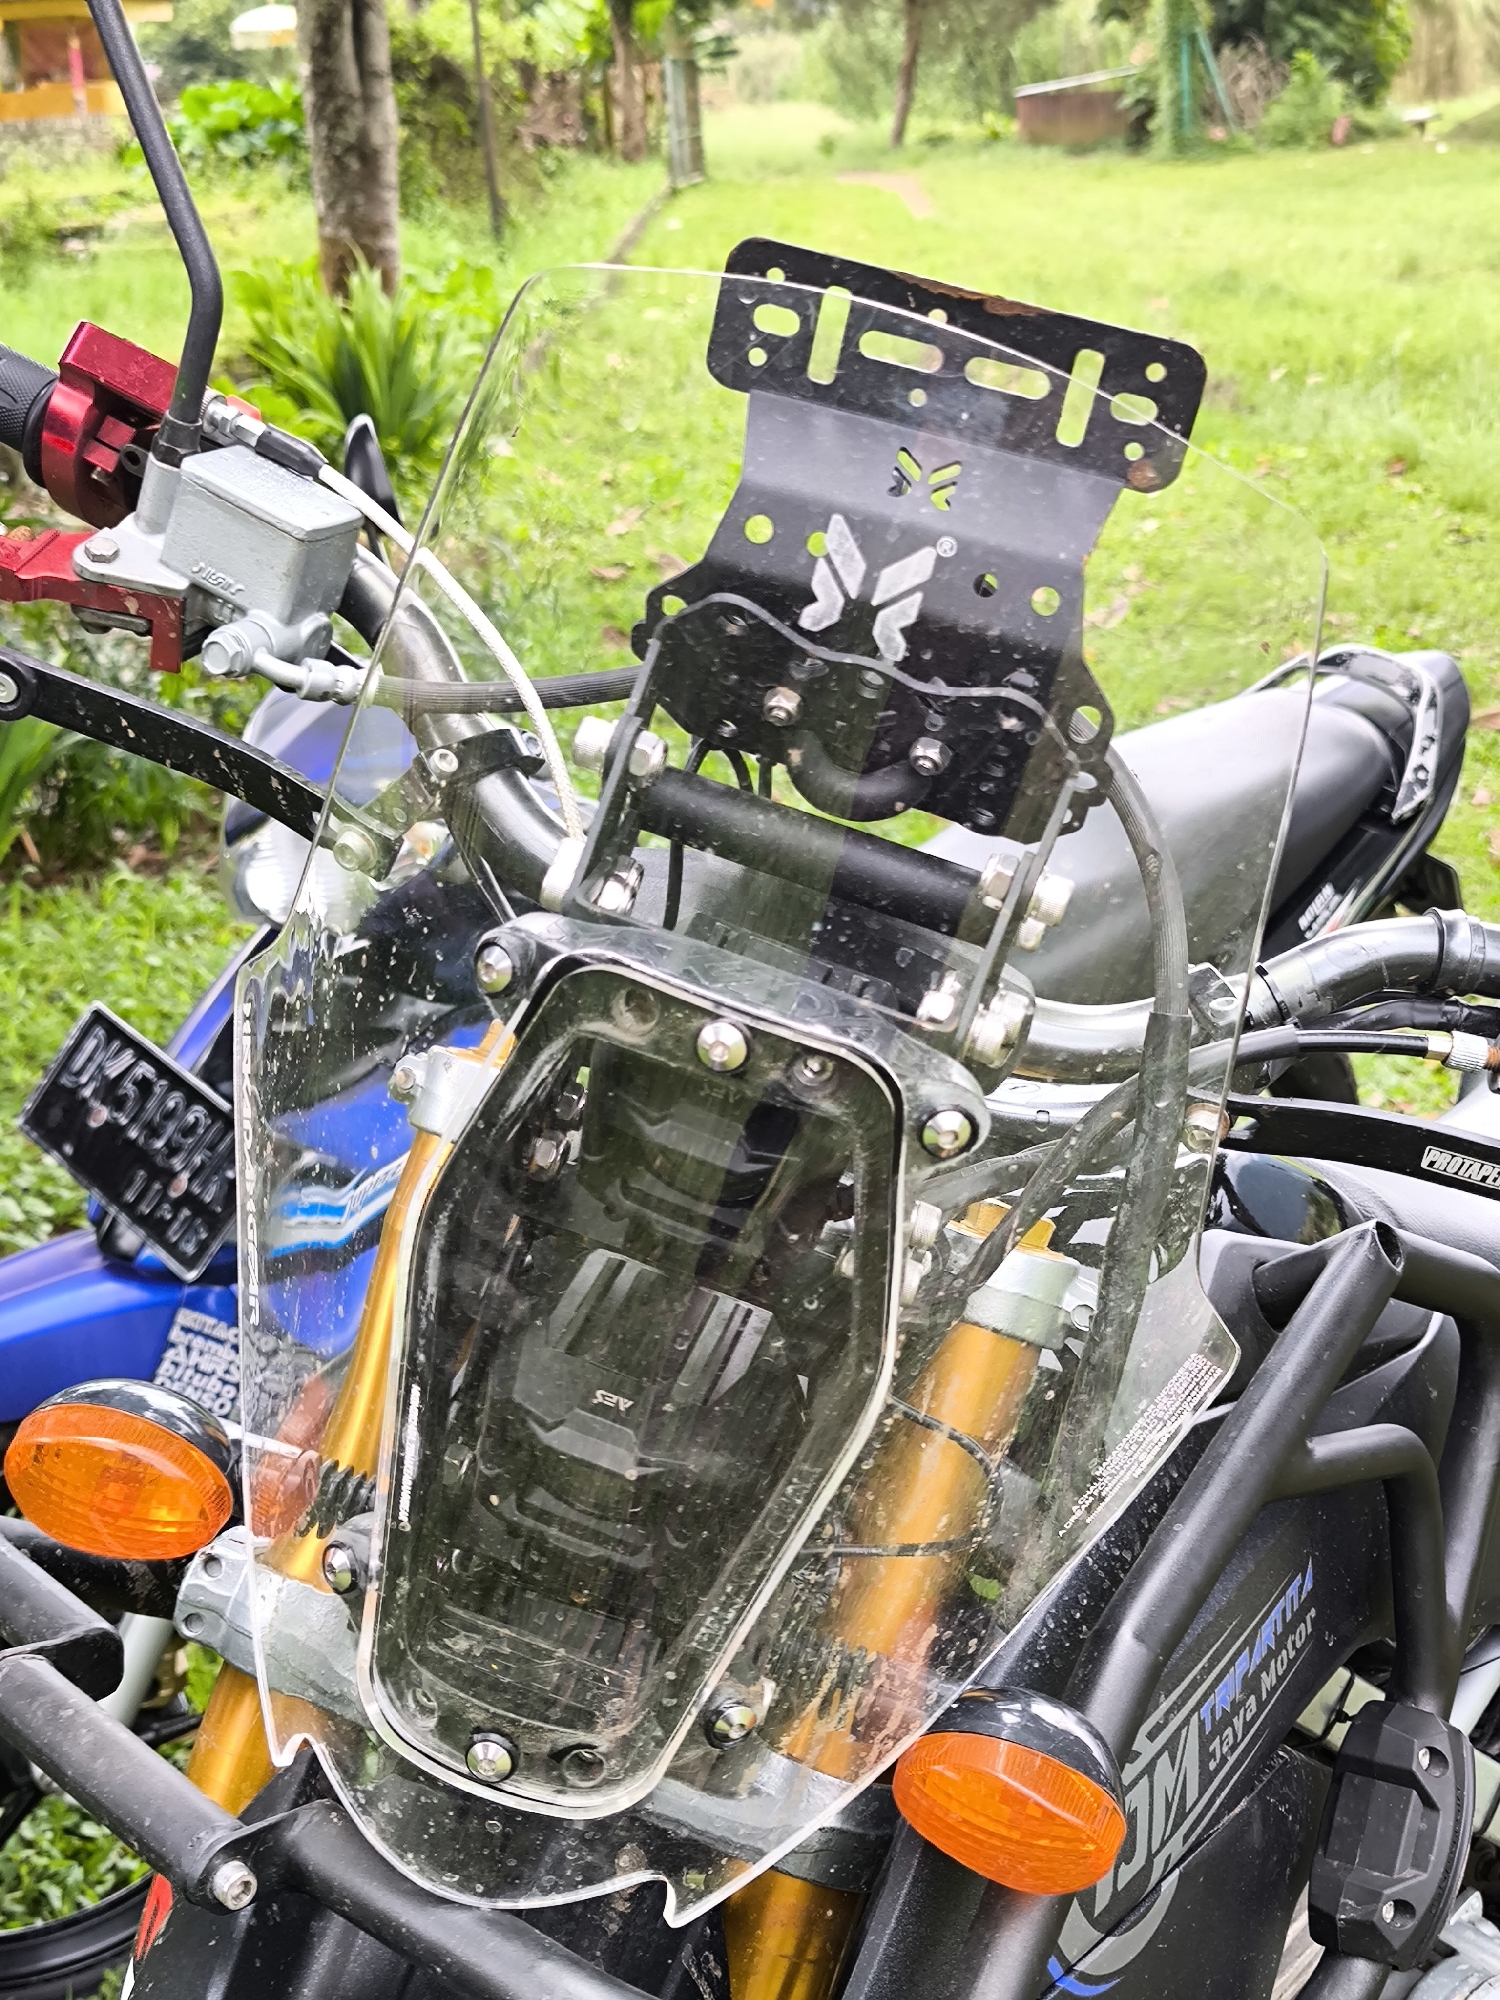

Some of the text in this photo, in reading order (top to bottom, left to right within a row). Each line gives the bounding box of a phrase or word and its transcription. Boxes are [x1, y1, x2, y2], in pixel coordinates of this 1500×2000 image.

[1427, 1149, 1500, 1187] PROTAPE
[1077, 1449, 1124, 1505] CHALLENGE
[1123, 1427, 1142, 1449] FOR
[1141, 1394, 1169, 1427] THOSE
[1167, 1370, 1189, 1395] WHO
[1153, 1352, 1198, 1403] INDONESIA
[1063, 1494, 1093, 1529] DREAM
[1093, 1474, 1111, 1495] FOR
[1110, 1442, 1138, 1474] THOSE
[1137, 1417, 1158, 1442] WHO
[1156, 1393, 1177, 1418] STAY
[1200, 1557, 1314, 1735] TRIPARTITA
[1209, 1608, 1316, 1772] Jaya Motor
